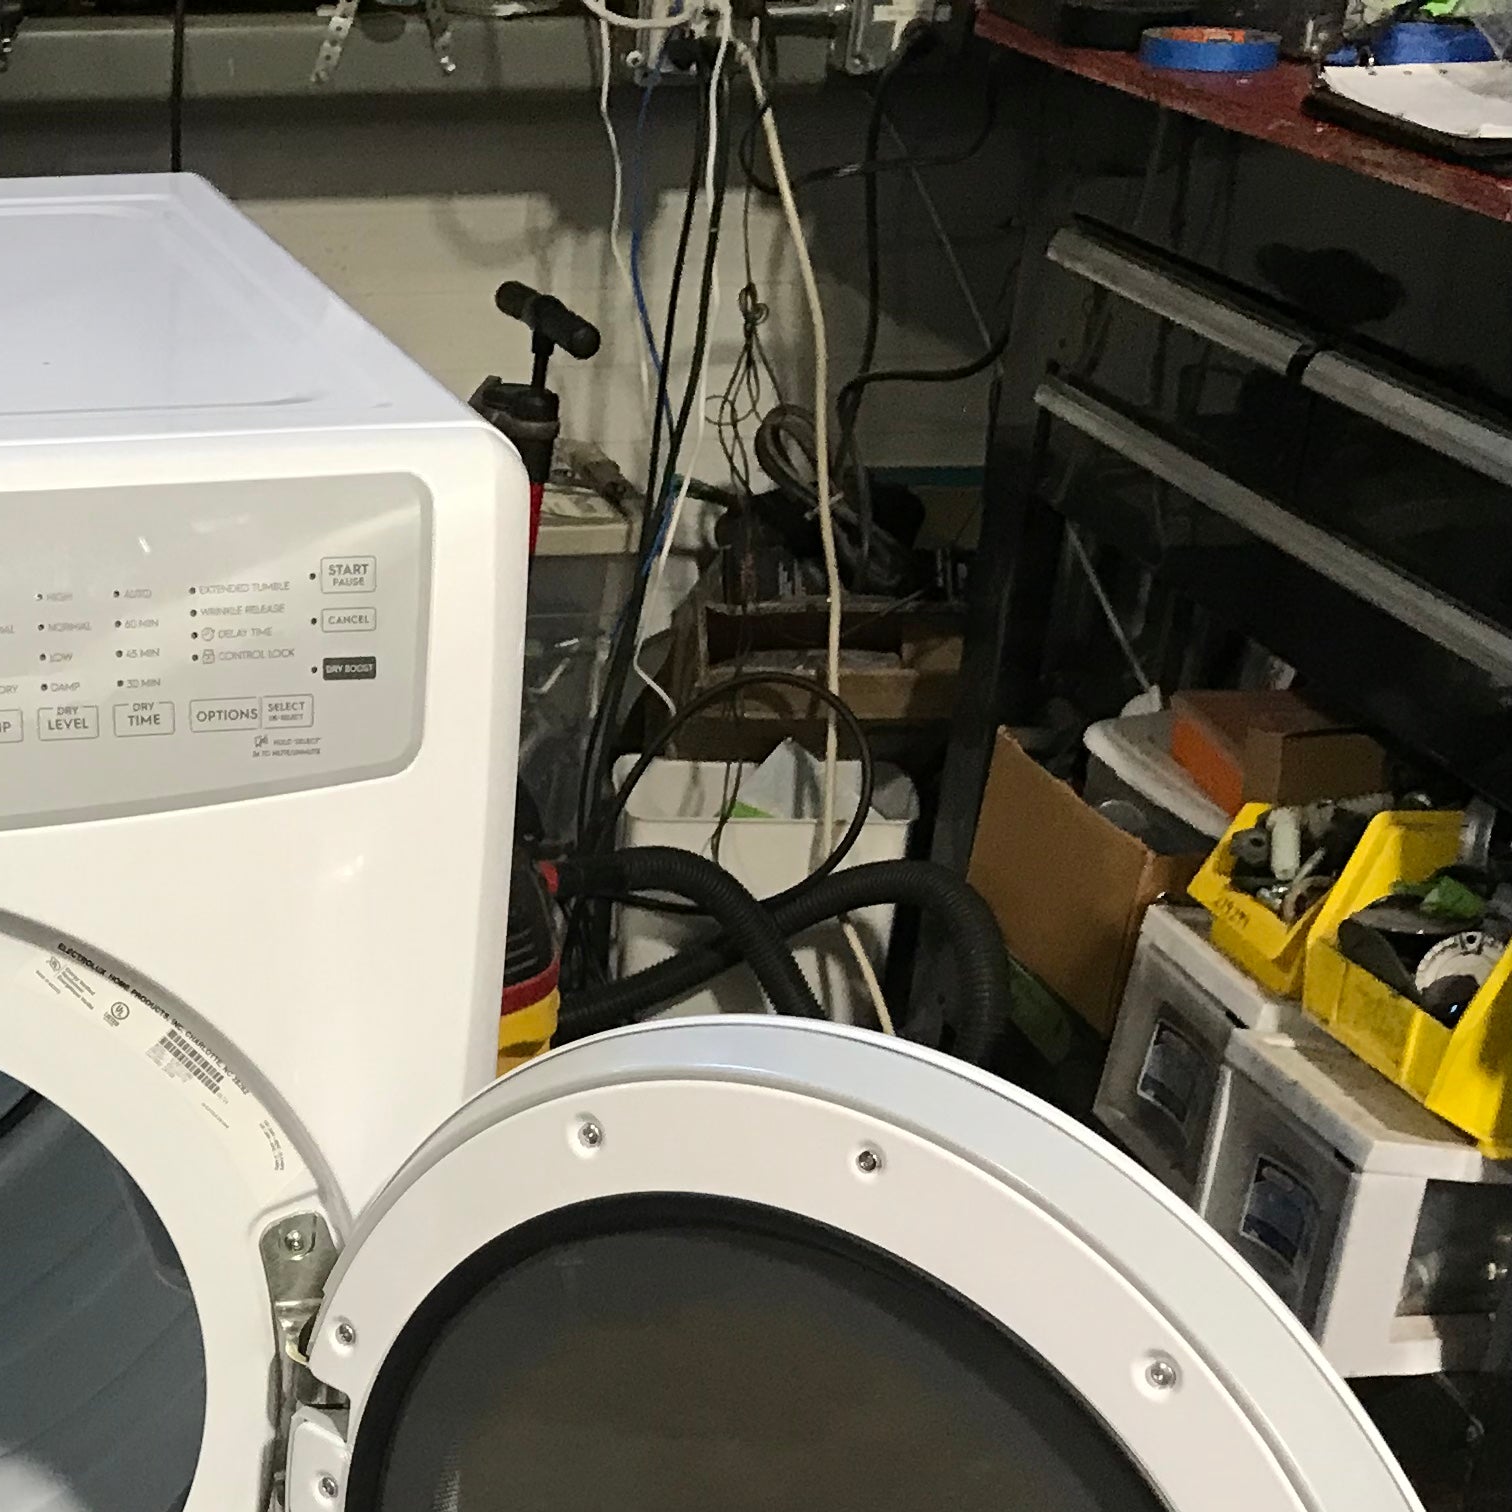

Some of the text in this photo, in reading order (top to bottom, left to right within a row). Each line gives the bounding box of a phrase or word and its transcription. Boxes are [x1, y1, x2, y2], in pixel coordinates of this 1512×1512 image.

[328, 563, 369, 576] START
[333, 577, 365, 587] PAUSE
[328, 615, 369, 625] CANCEL
[218, 630, 248, 639] DELAY
[50, 652, 74, 663] LOW
[219, 648, 295, 661] CONTROL LOCK
[326, 664, 344, 674] DRY
[50, 681, 80, 692] DAMP
[57, 706, 78, 716] DRY
[132, 703, 154, 713] DRY
[268, 701, 305, 712] SELECT
[128, 714, 161, 727] TIME
[196, 708, 258, 723] OPTIONS
[48, 718, 88, 731] LEVEL
[57, 942, 106, 977] ELECTROLUX
[108, 973, 130, 992] HOME
